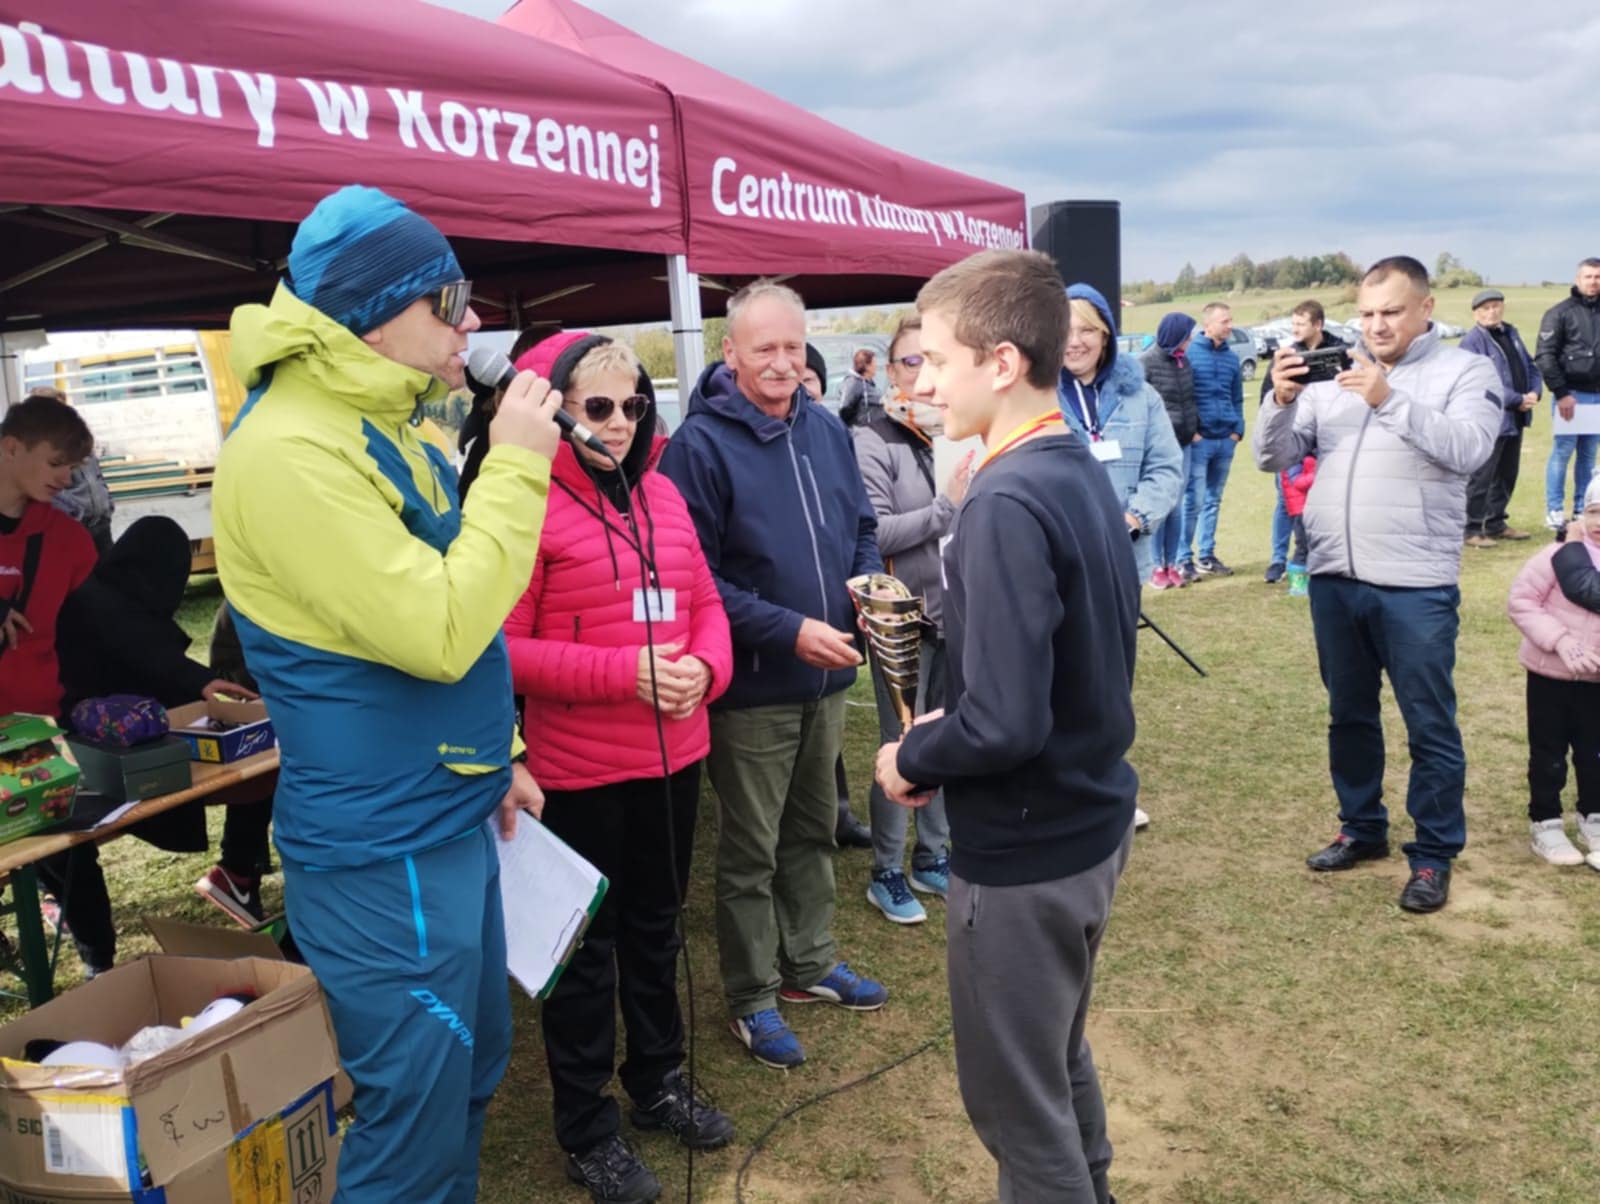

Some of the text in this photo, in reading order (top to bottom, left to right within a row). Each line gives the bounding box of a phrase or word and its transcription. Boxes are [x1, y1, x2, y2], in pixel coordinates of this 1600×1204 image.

[296, 78, 369, 139] w
[386, 88, 661, 208] Korzennej
[712, 156, 857, 226] Centrum
[933, 211, 958, 241] w
